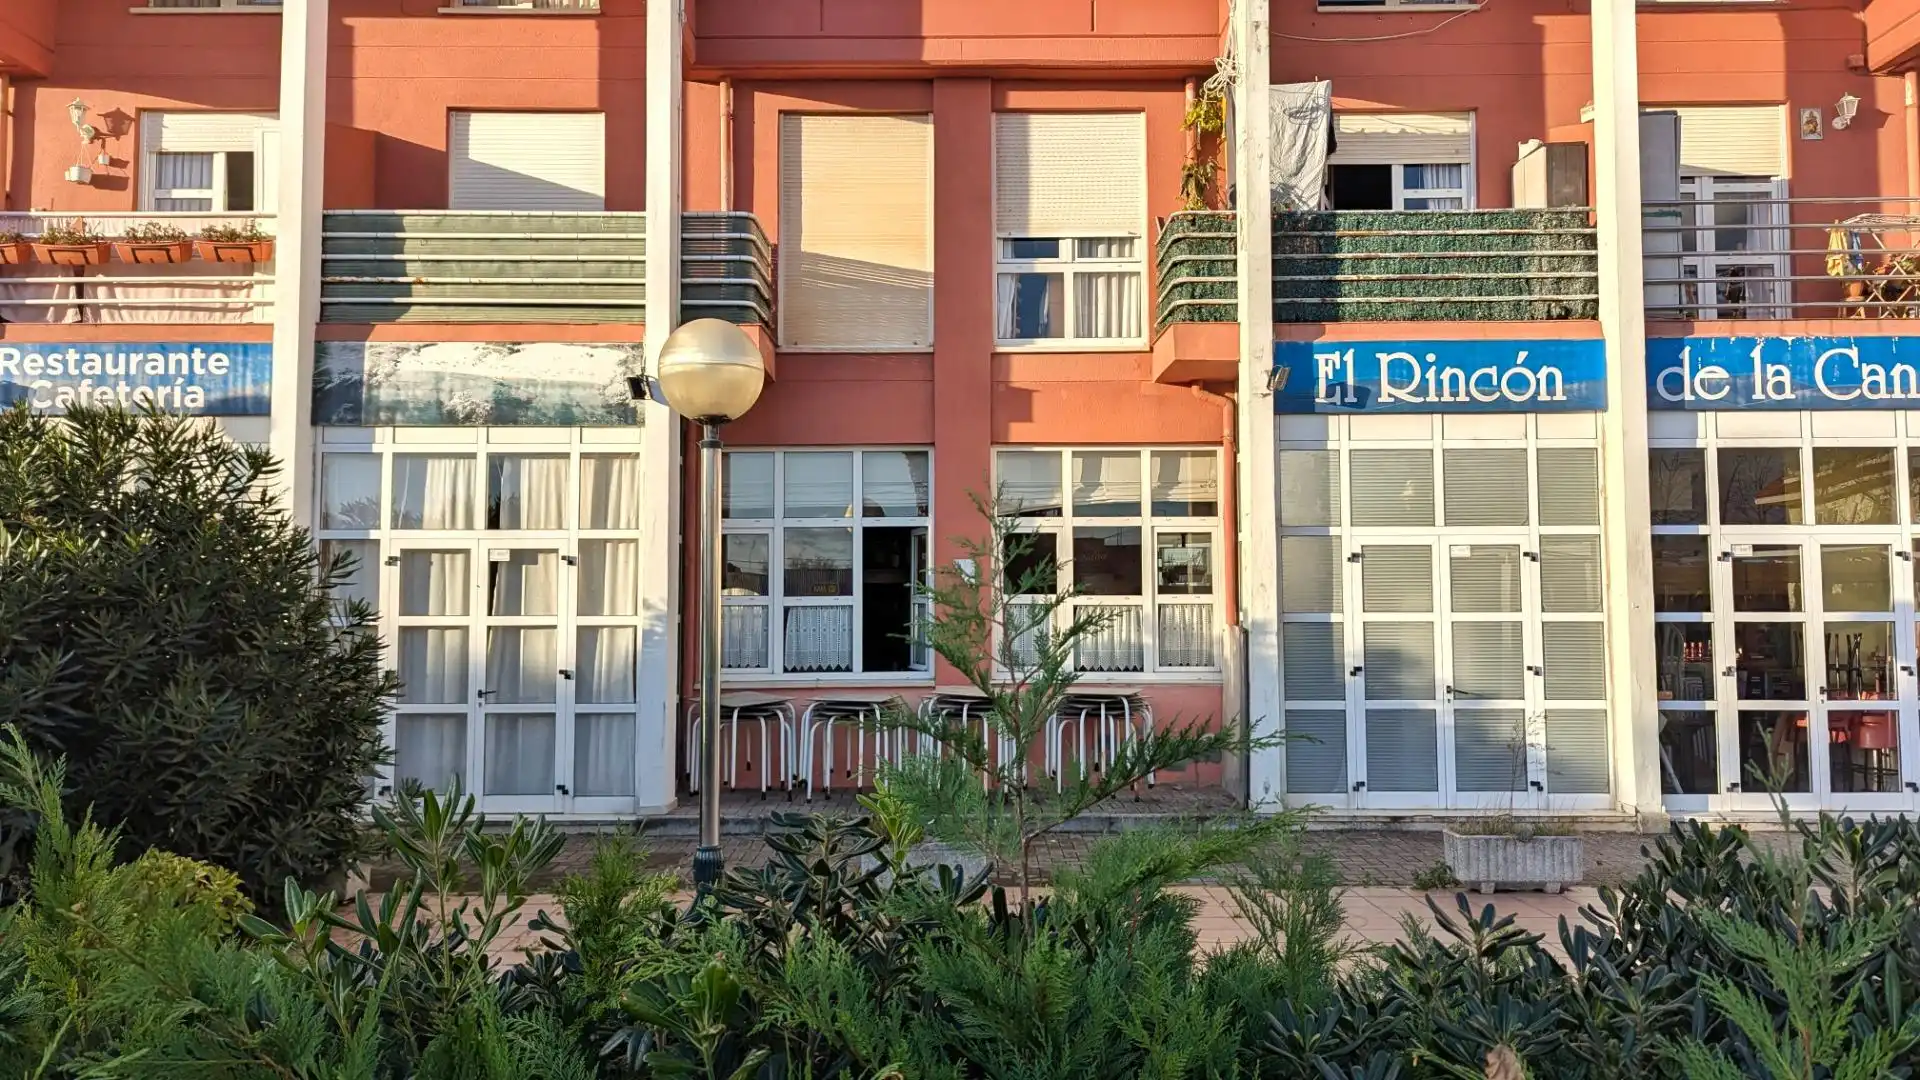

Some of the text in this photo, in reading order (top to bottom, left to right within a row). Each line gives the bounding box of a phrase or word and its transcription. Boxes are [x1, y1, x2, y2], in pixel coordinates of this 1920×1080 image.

[0, 347, 230, 376] Restaurante
[1313, 348, 1567, 405] El Rincón
[1656, 342, 1920, 402] de la Can
[28, 377, 206, 409] Cafetería
